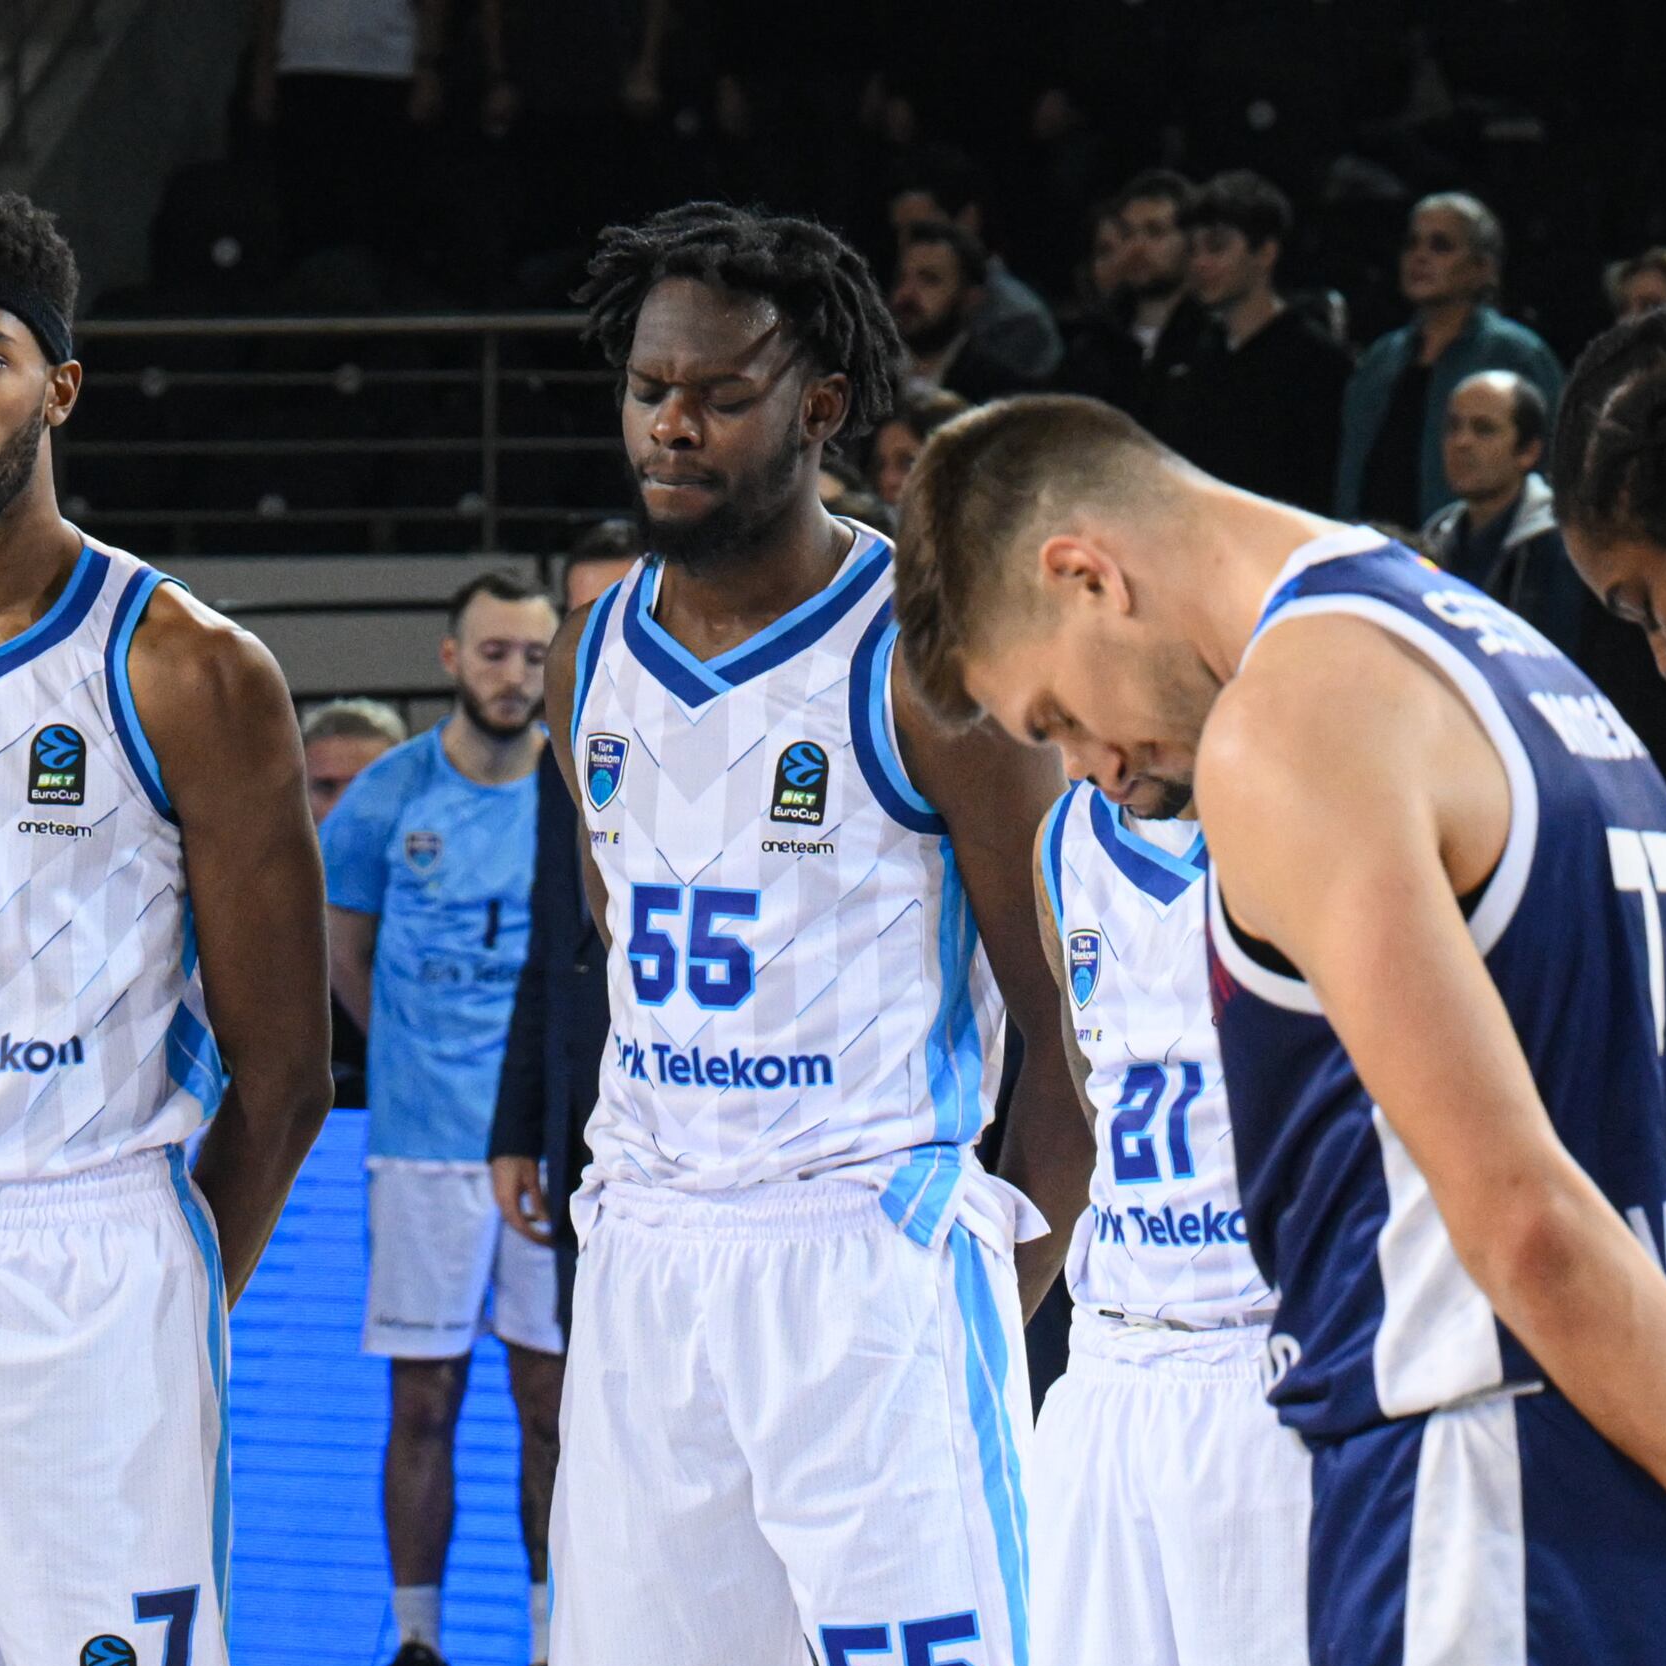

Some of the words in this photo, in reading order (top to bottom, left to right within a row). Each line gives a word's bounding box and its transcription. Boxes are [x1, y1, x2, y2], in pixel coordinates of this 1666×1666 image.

[597, 741, 614, 753] Türk
[590, 751, 621, 765] Telekom
[36, 773, 77, 787] BKT
[31, 788, 81, 802] EuroCup
[780, 789, 818, 806] BKT
[773, 805, 821, 822] EuroCup
[17, 820, 93, 838] oneteam
[761, 839, 835, 855] oneteam
[626, 882, 762, 1012] 55
[650, 1041, 835, 1090] Telekom
[1110, 1061, 1205, 1186] 21
[1127, 1201, 1249, 1247] Teleko
